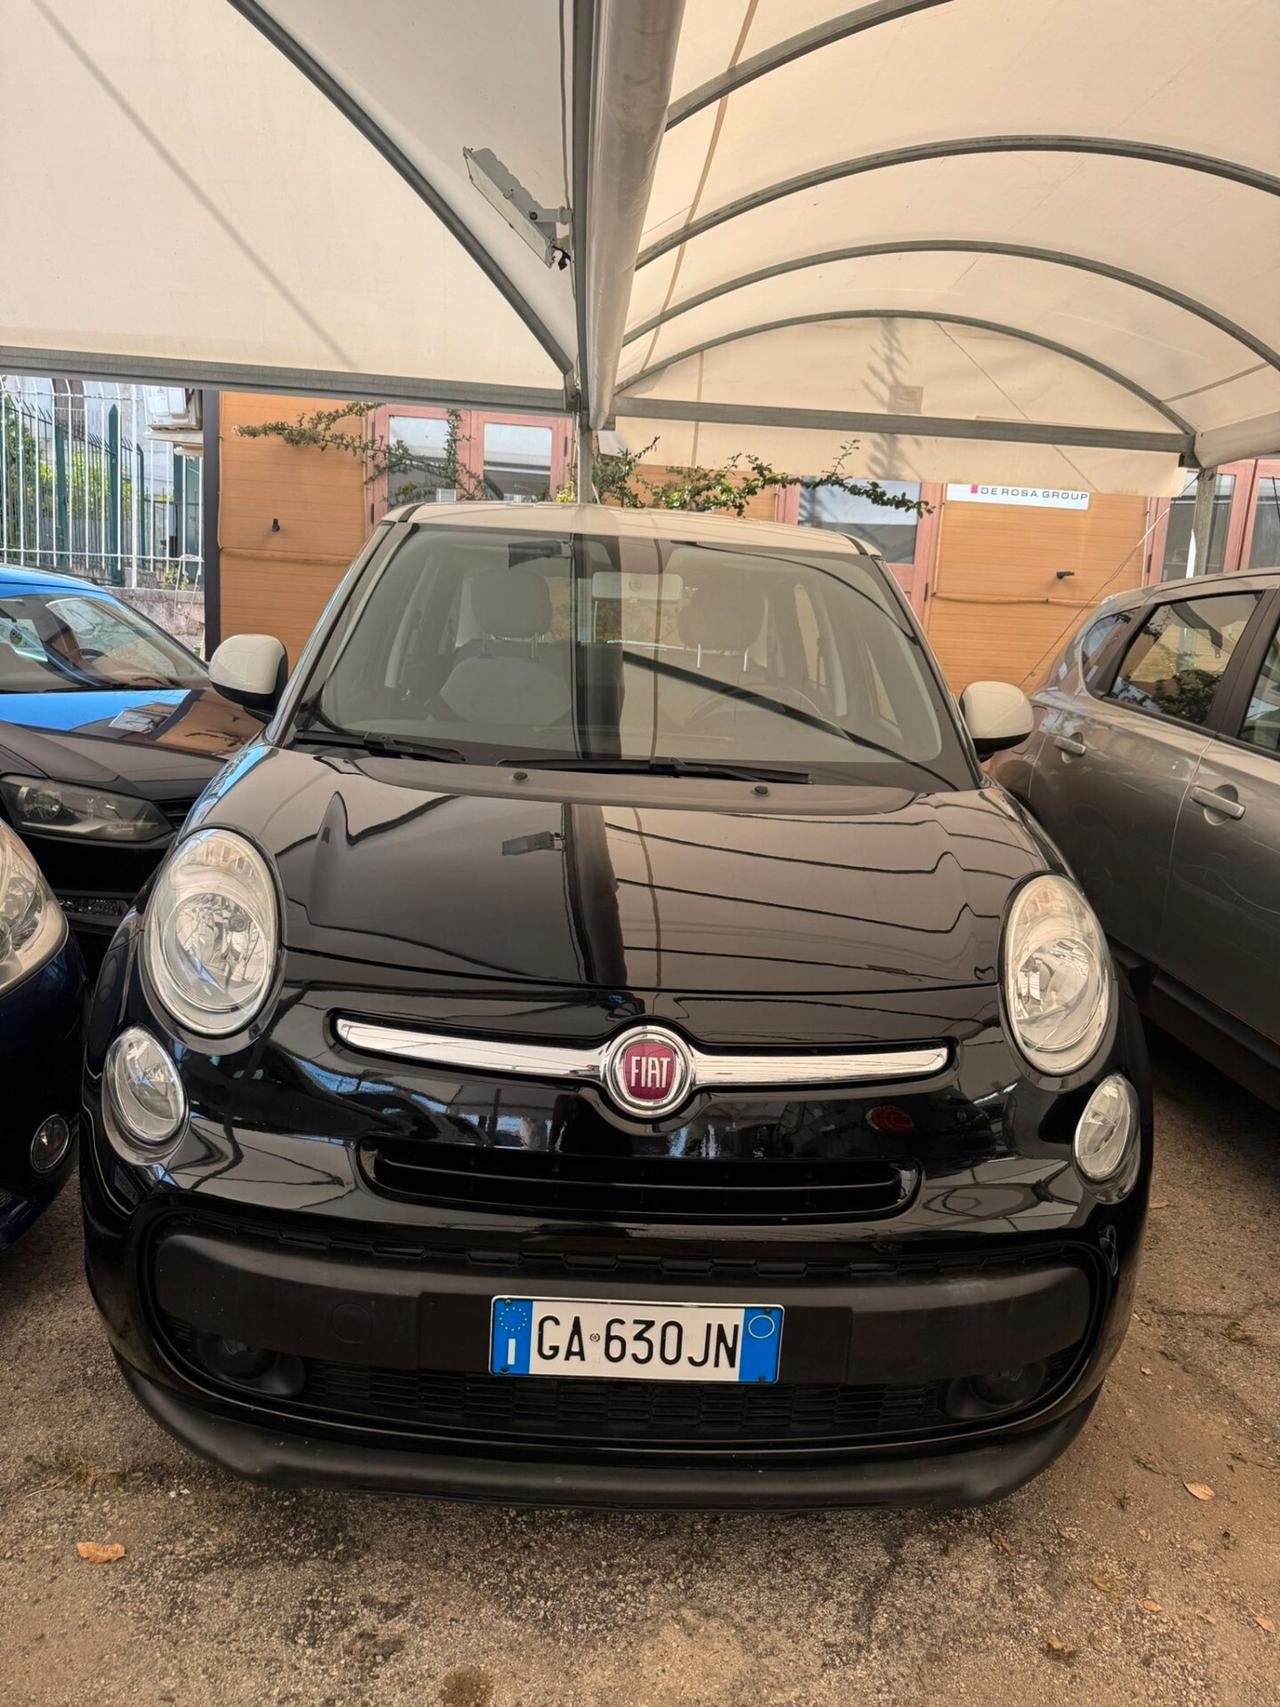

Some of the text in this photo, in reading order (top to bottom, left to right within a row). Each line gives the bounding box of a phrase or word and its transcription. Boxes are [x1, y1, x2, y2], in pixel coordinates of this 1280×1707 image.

[980, 487, 1088, 501] DE ROSA GROUP
[630, 1056, 671, 1089] FIAT
